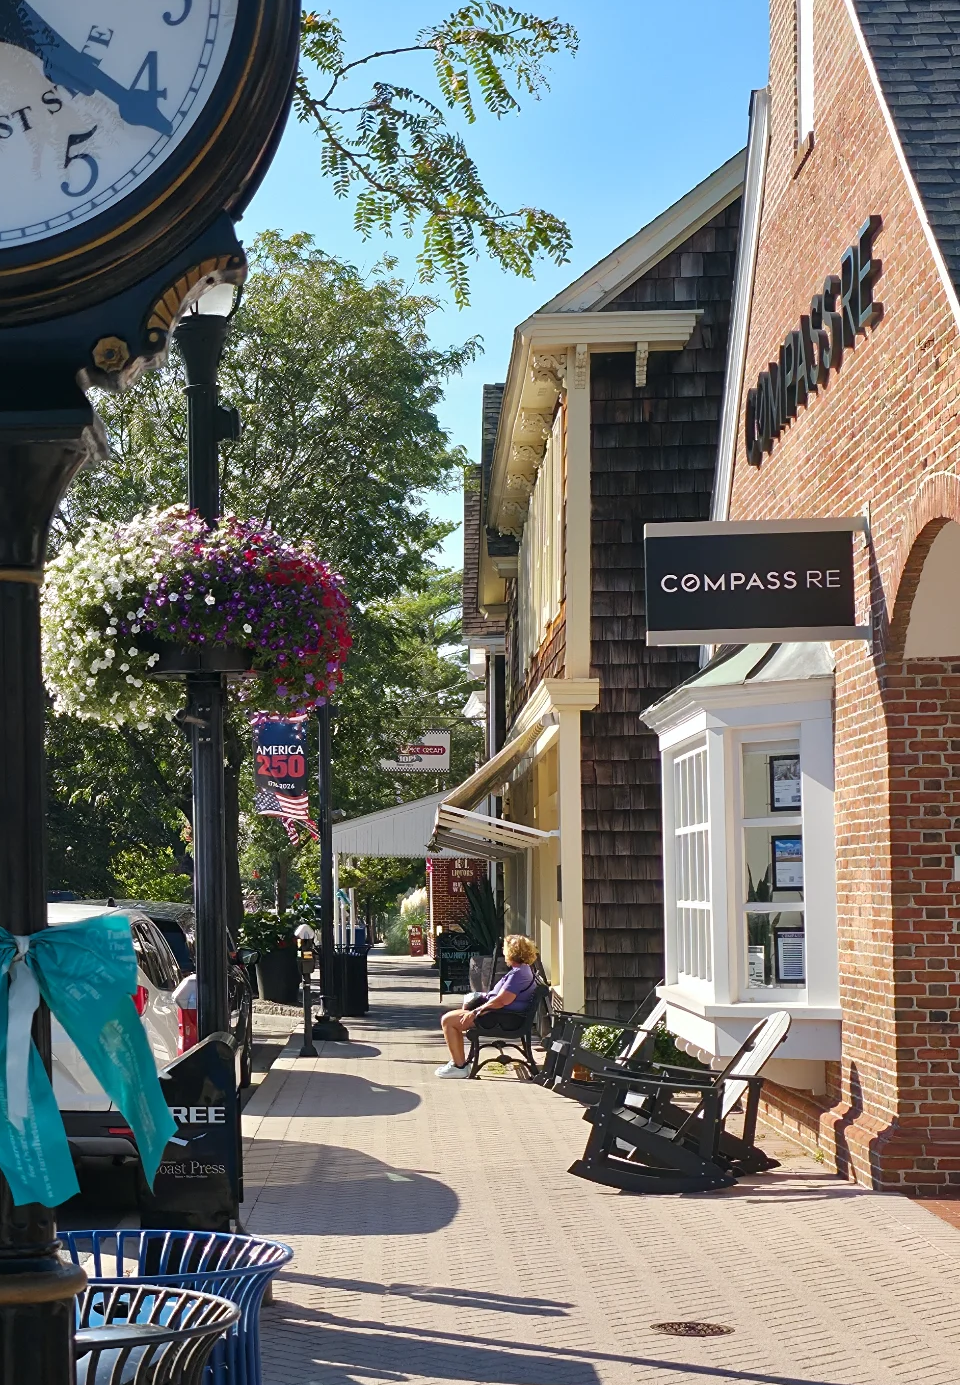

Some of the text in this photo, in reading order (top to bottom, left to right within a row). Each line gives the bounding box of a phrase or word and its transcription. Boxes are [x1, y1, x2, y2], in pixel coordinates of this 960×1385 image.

[125, 50, 168, 110] 4
[60, 124, 99, 197] 5
[745, 214, 884, 467] COMPASS RE
[660, 569, 841, 593] COMPASS RE
[256, 745, 304, 755] AMERICA
[256, 754, 305, 778] 250
[168, 1106, 226, 1123] REE
[158, 1160, 226, 1175] oast Press
